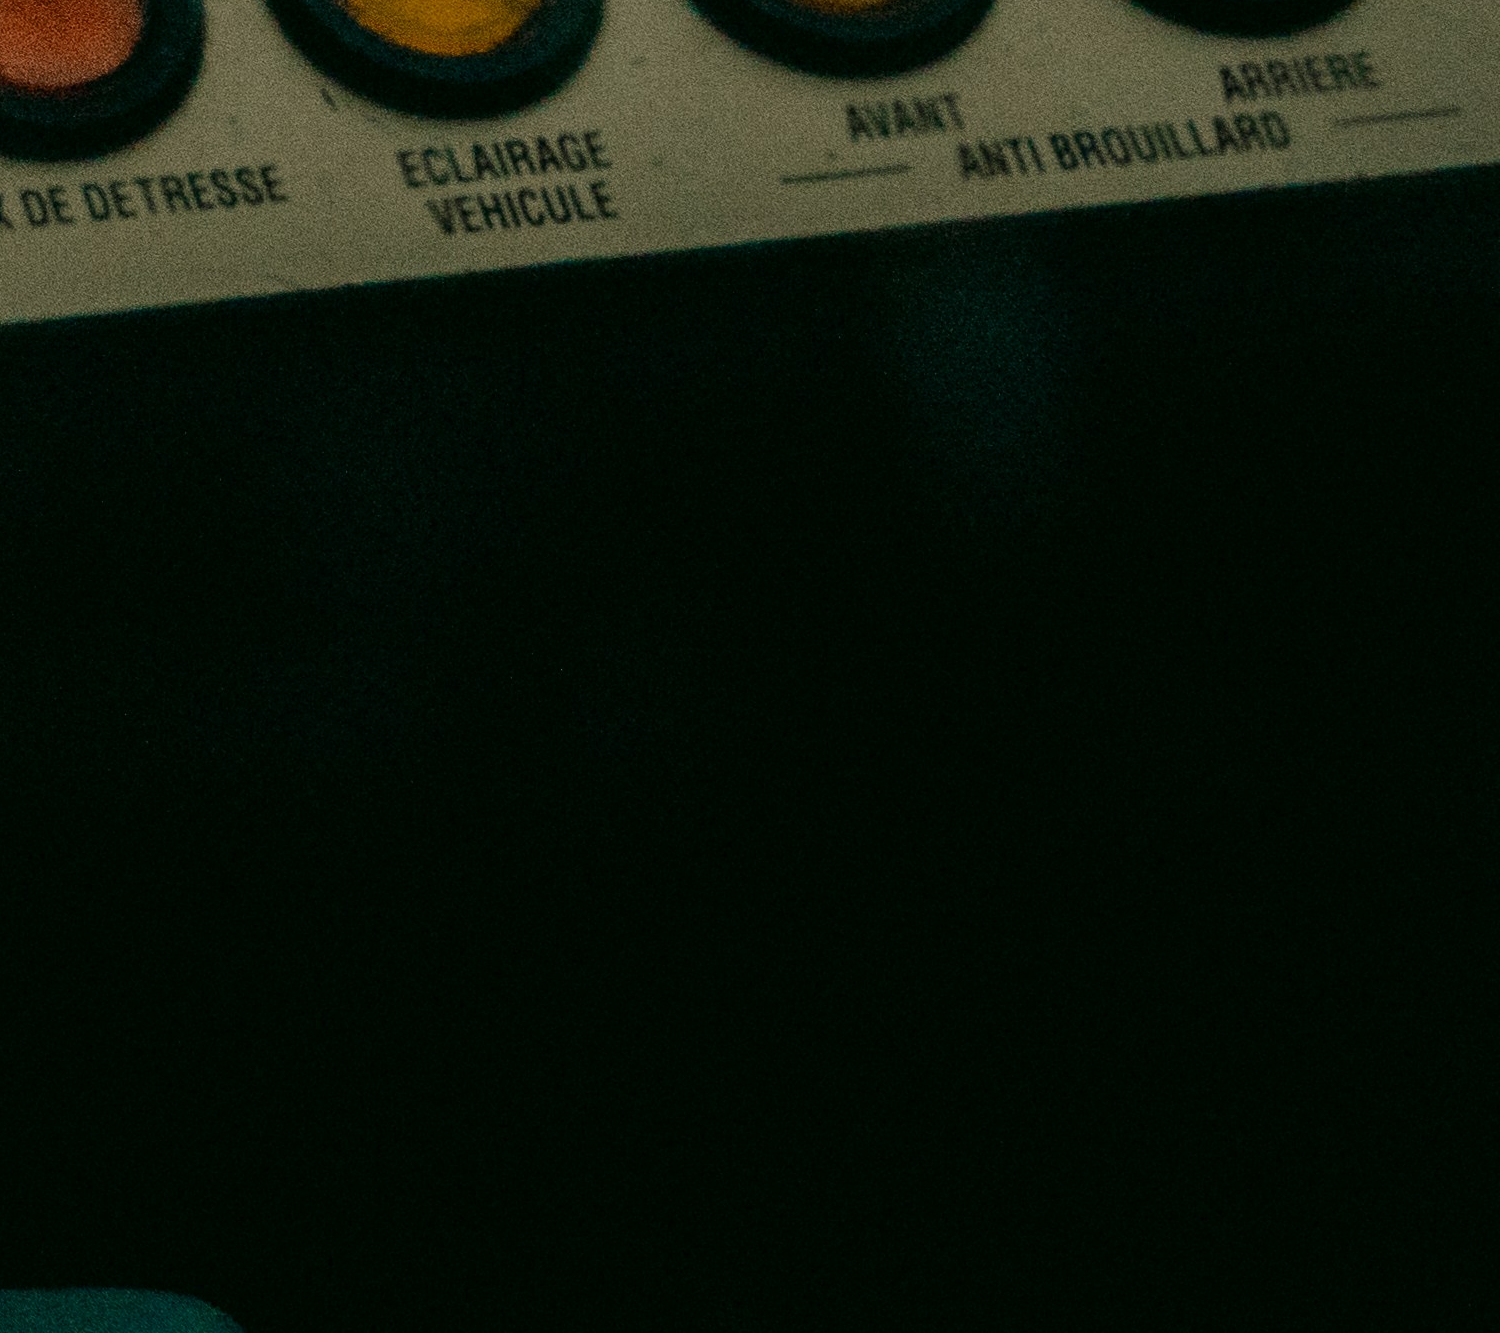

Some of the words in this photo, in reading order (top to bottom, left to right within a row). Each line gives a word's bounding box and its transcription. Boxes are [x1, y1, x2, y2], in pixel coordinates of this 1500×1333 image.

[1218, 51, 1382, 103] ARRIERE
[846, 93, 965, 142] AVANT
[954, 136, 1046, 180] ANTI
[1049, 110, 1294, 173] BROUILLARD
[396, 130, 612, 188] ECLAIRAGE
[19, 184, 75, 230] DE
[82, 164, 290, 223] DETRESSE
[424, 181, 619, 234] VEHICULE
